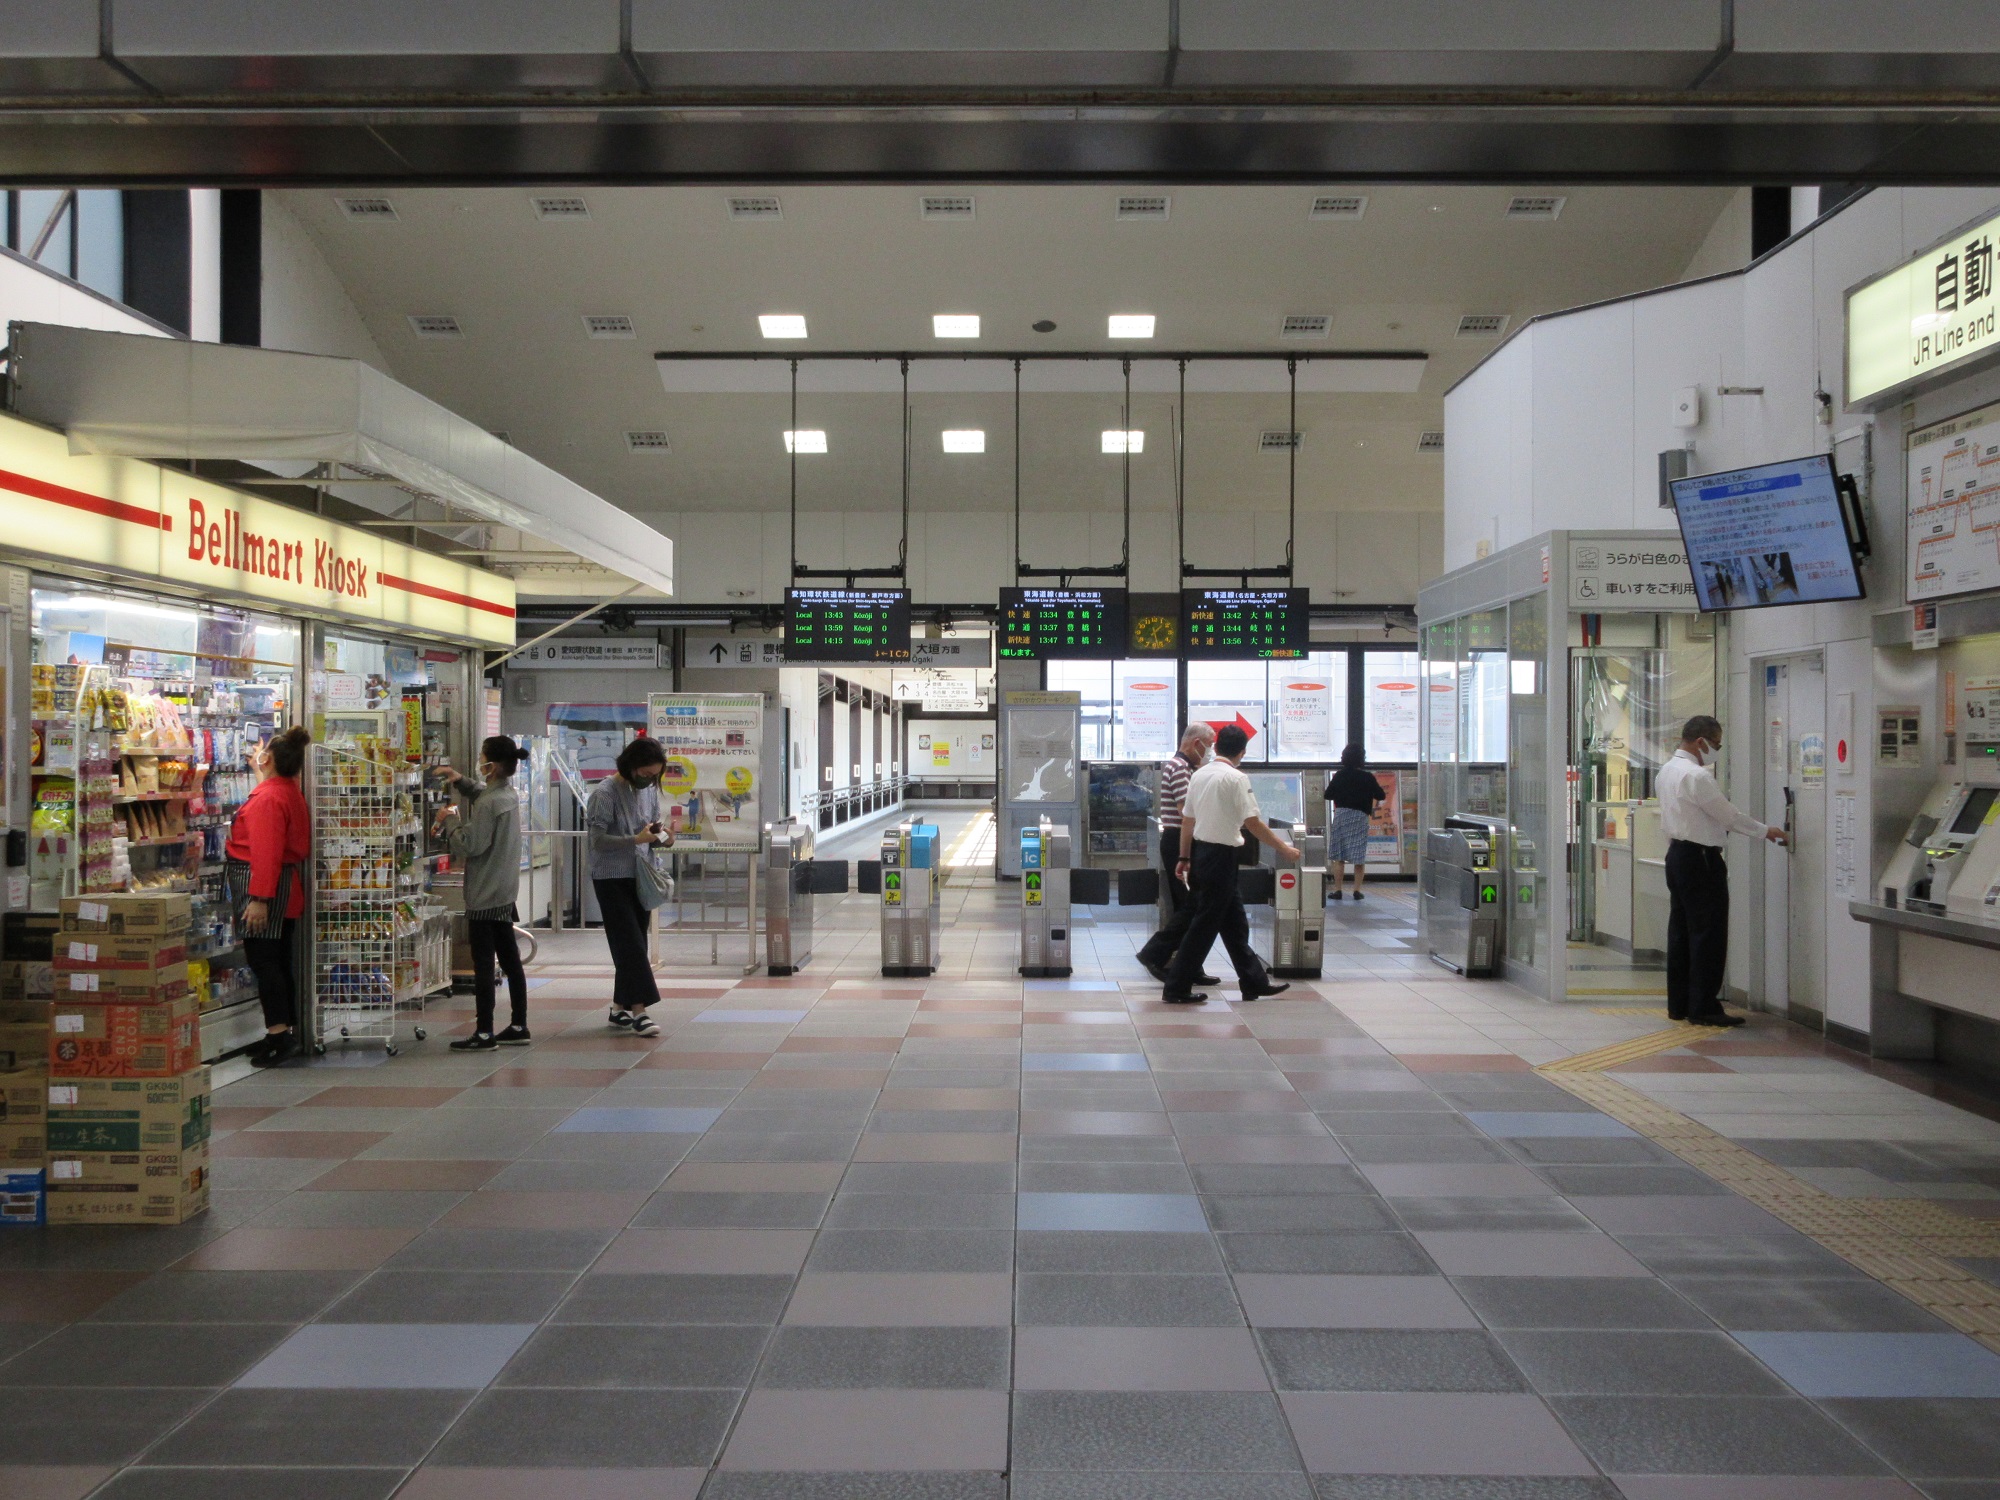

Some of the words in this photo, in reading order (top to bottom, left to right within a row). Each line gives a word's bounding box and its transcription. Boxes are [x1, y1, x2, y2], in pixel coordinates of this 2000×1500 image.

[1936, 235, 2000, 313] 自動
[1914, 336, 1930, 366] JR
[1935, 326, 1963, 356] Line
[1968, 306, 1994, 342] and
[188, 498, 303, 584] Bellmart
[314, 538, 367, 598] Kiosk
[1606, 583, 1695, 594] 車いすをご利用
[547, 647, 556, 658] 0
[916, 644, 960, 655] 大垣方面
[1025, 852, 1037, 863] ic
[116, 1007, 125, 1054] BLEND
[127, 1007, 137, 1055] KYOTO
[60, 1042, 76, 1059] 茶
[82, 1041, 112, 1057] 京都
[82, 1058, 132, 1075] ブレンド
[78, 1127, 110, 1144] 生茶
[146, 1166, 162, 1176] 600
